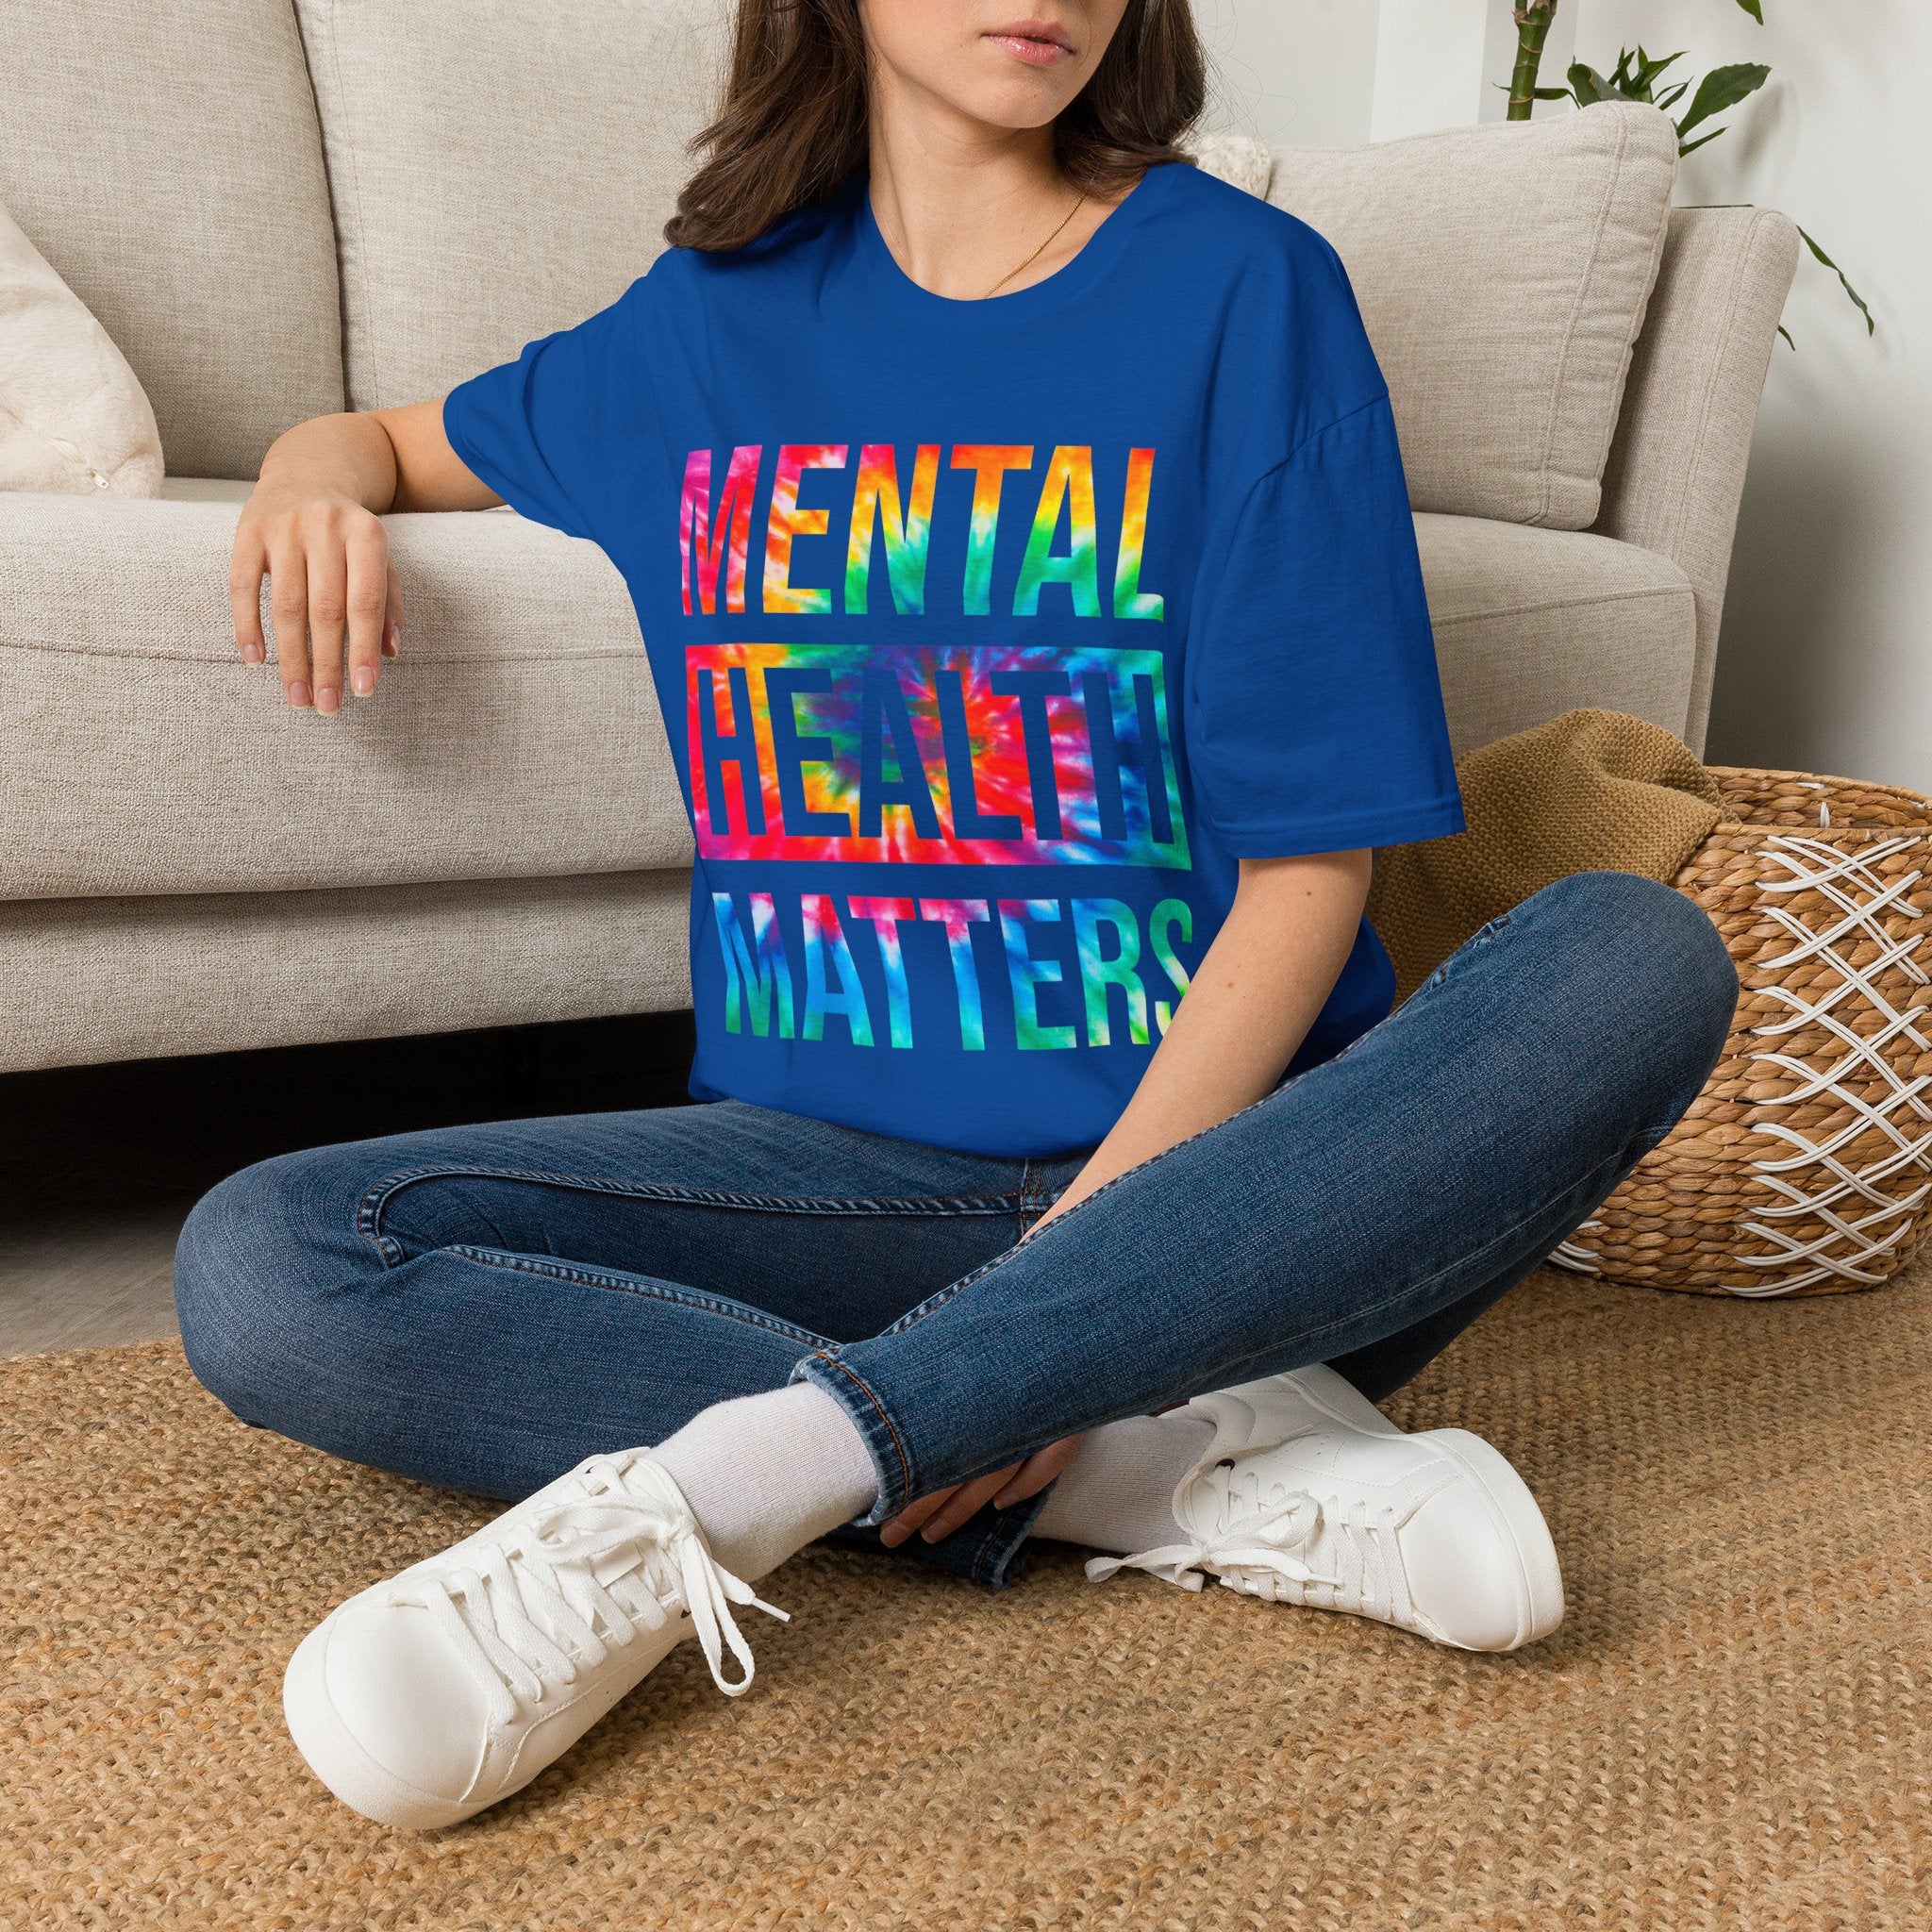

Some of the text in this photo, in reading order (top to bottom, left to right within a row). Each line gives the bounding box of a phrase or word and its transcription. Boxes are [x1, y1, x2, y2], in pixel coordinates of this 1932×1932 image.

[679, 444, 1164, 624] MENTAL
[697, 666, 1174, 845] HEALTH
[711, 891, 1192, 1051] MATTERS
